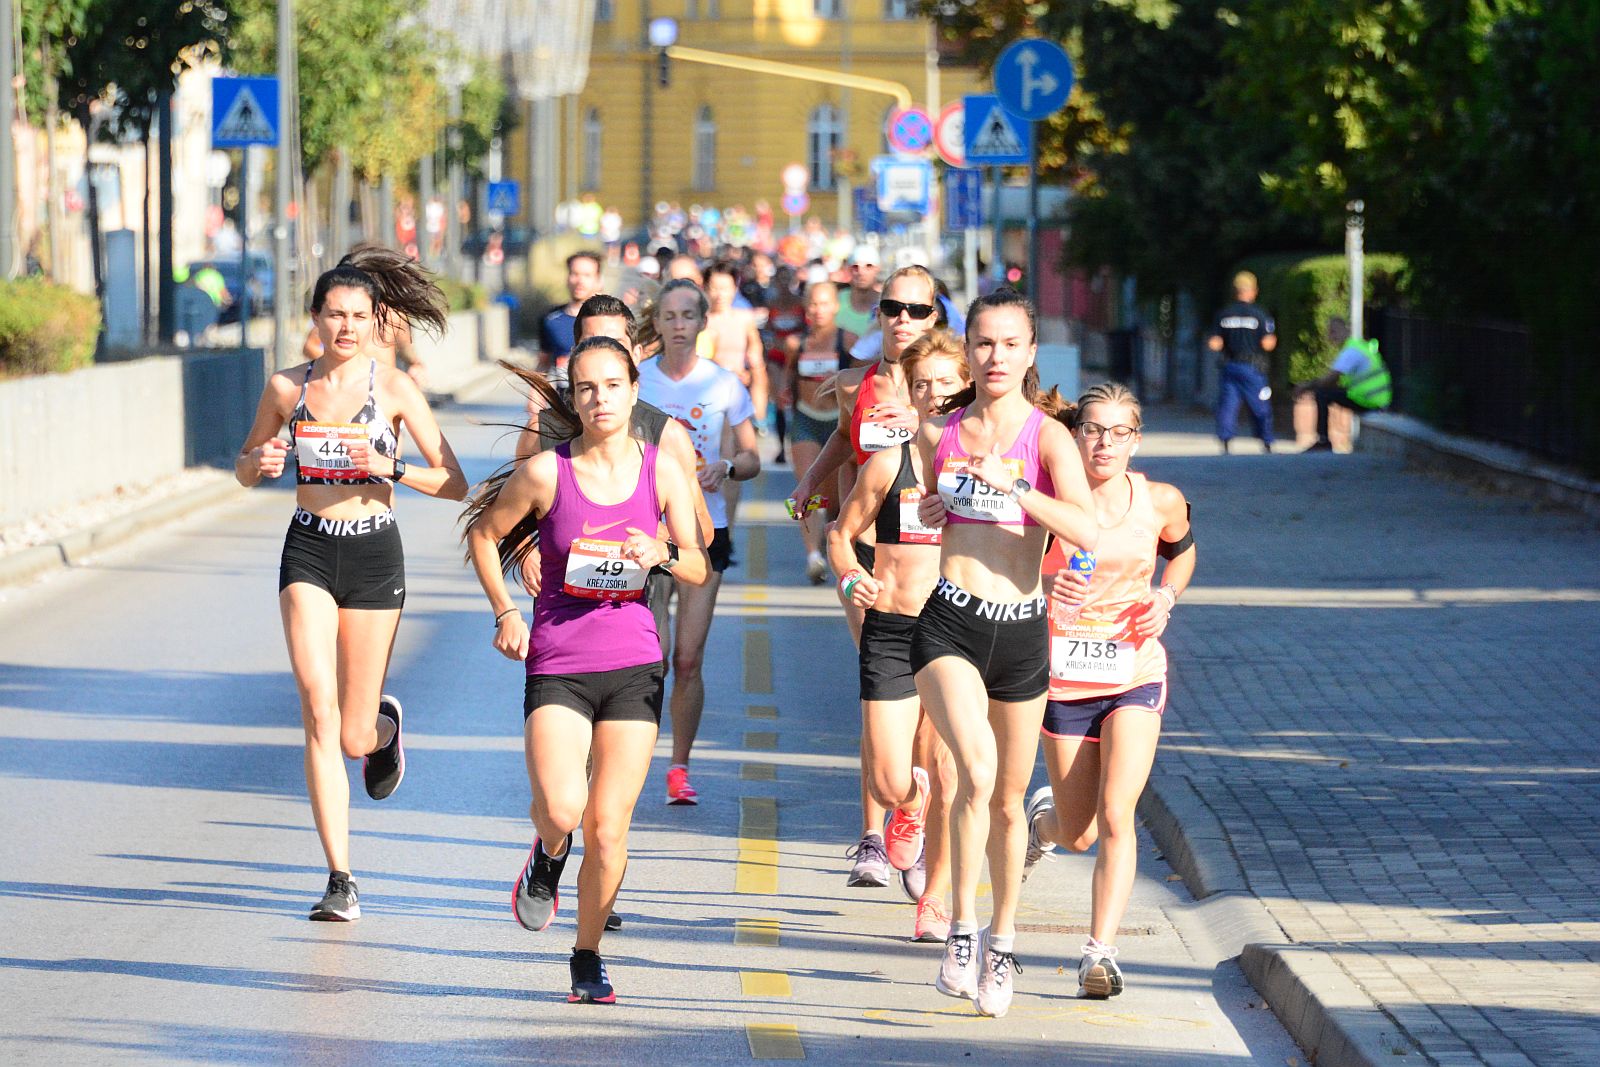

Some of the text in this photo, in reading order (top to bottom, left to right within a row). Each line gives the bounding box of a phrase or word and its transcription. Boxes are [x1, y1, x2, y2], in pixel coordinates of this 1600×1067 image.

[319, 441, 345, 457] 44
[953, 496, 1005, 510] GYÖRGY ATTILA
[317, 516, 372, 537] NIKE
[595, 560, 624, 576] 49
[586, 577, 604, 588] KRÉZ
[975, 599, 1033, 622] NIKE
[1068, 640, 1117, 659] 7138
